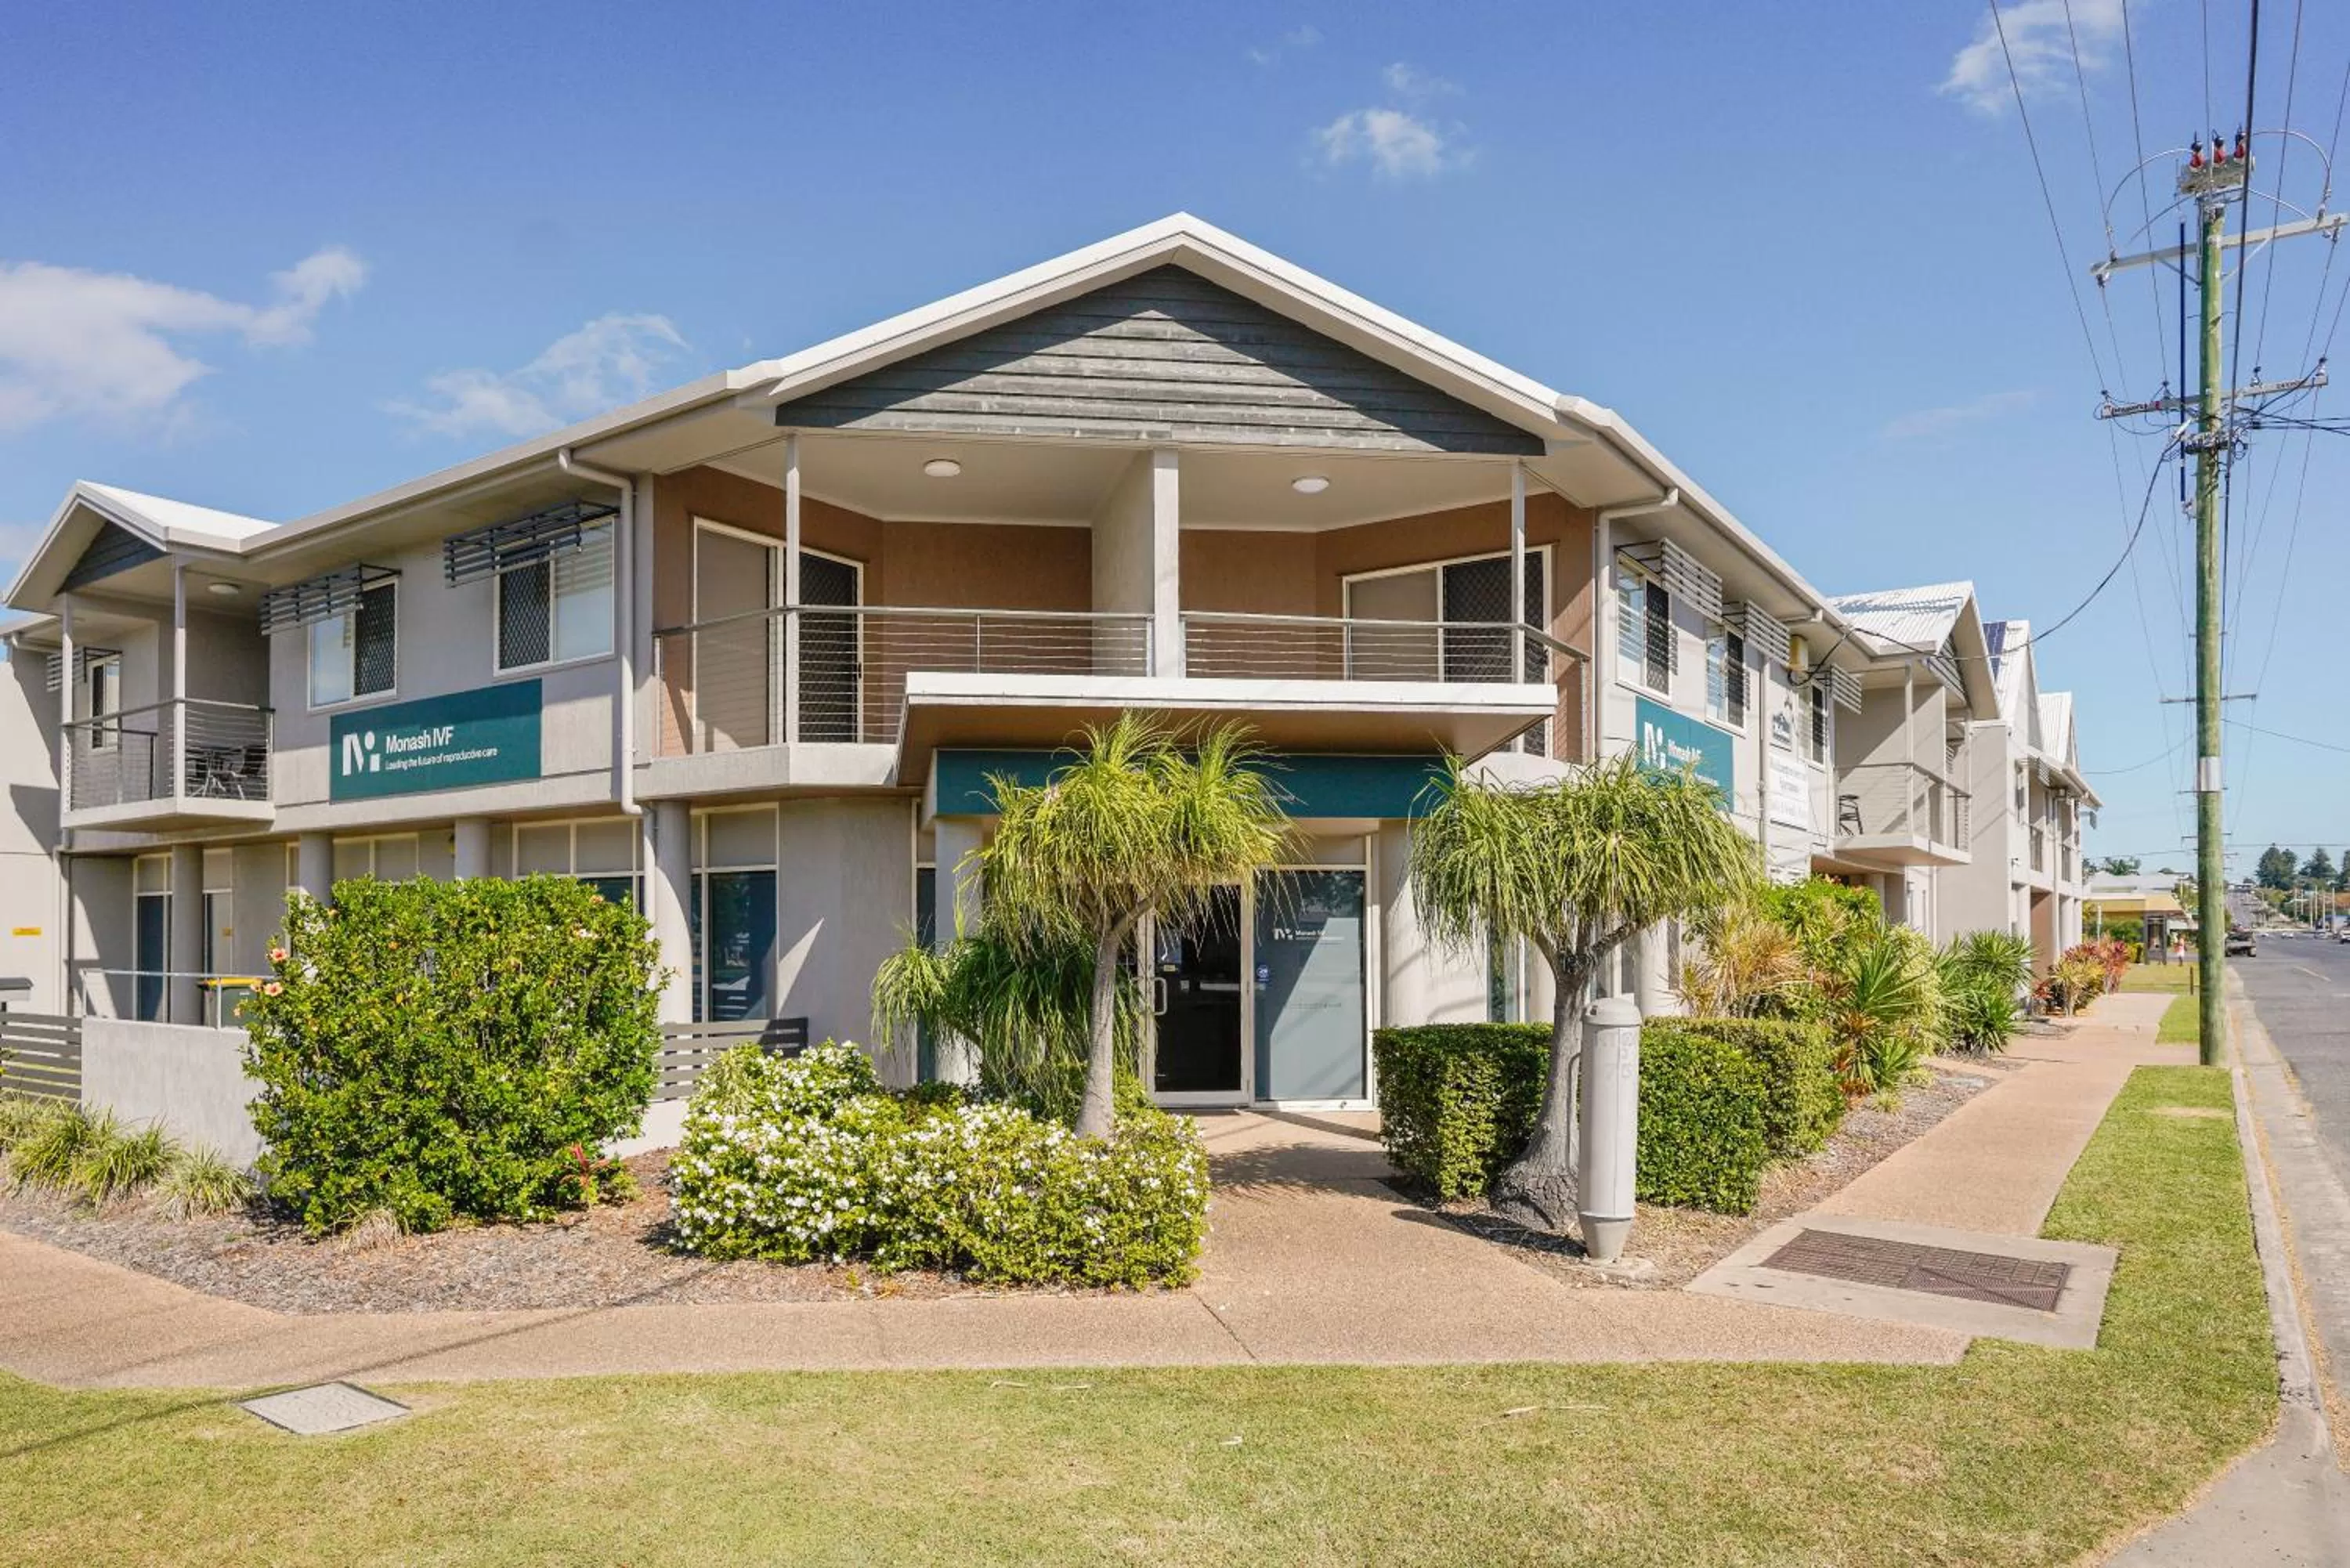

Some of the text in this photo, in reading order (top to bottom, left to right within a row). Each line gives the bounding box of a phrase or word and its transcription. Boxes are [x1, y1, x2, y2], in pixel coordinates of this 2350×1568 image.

[385, 726, 454, 753] Monash IVF
[483, 747, 497, 758] care
